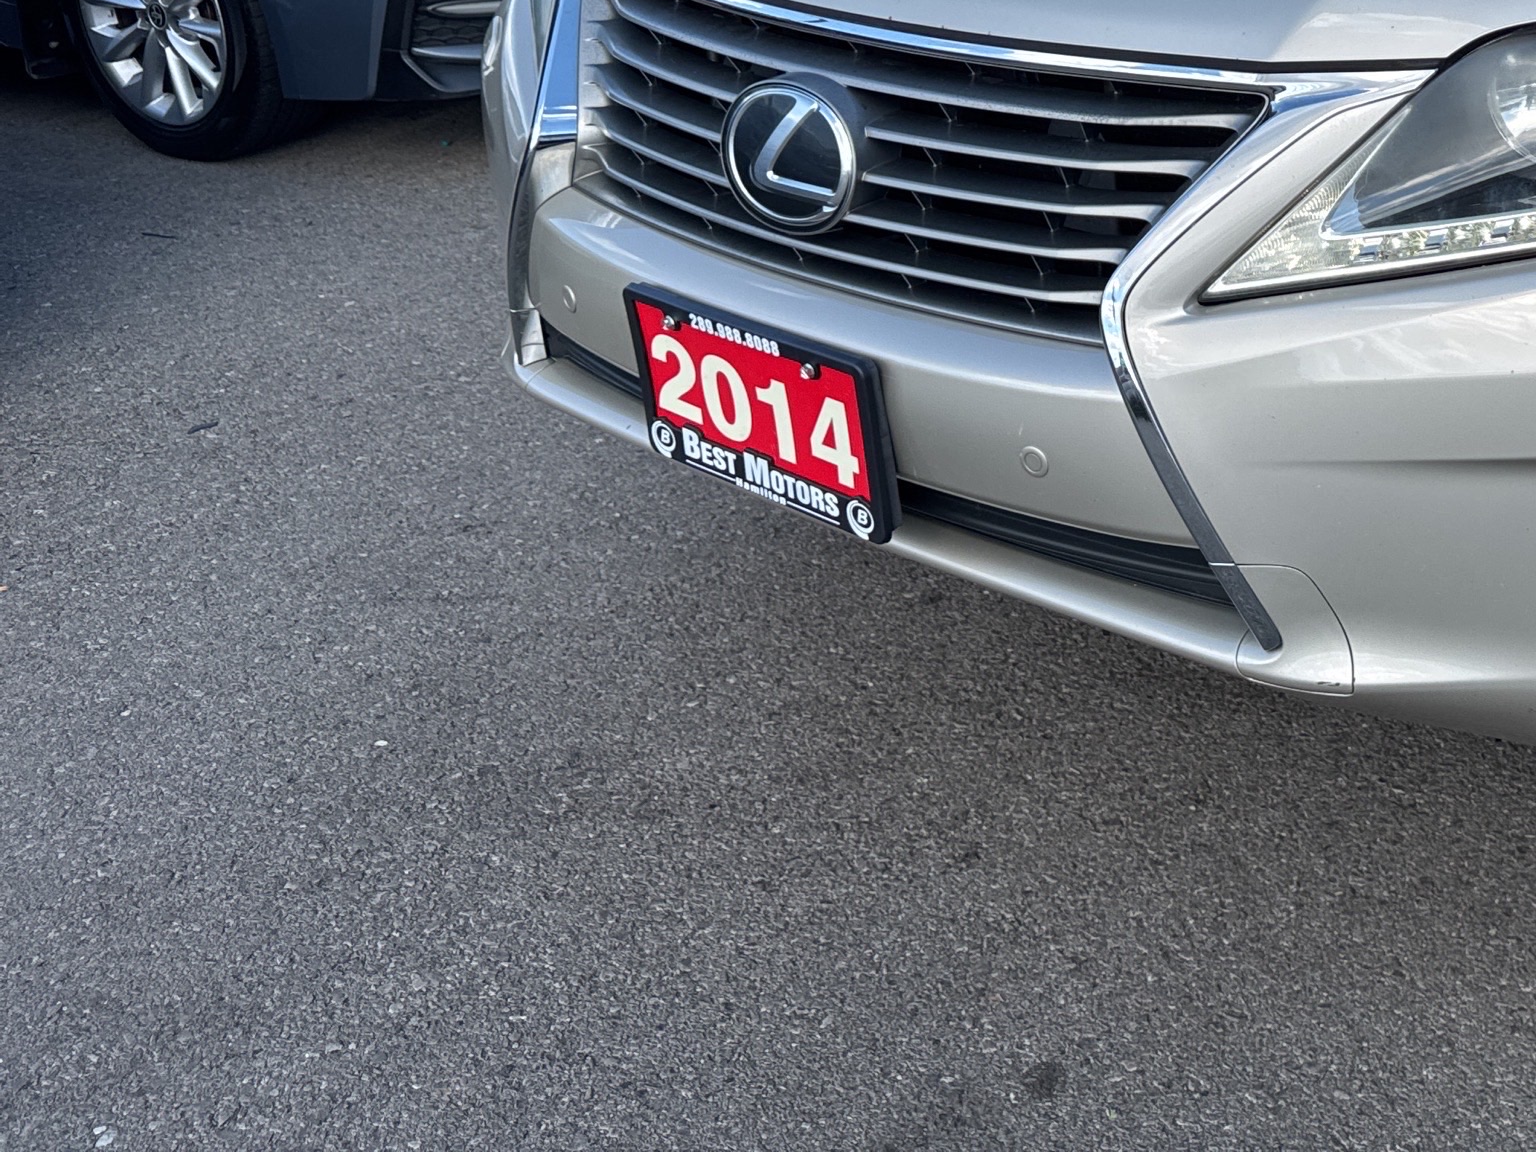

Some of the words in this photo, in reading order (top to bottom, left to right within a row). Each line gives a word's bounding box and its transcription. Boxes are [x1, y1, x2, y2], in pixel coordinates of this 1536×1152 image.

[688, 312, 781, 357] 289.988.8088
[650, 333, 860, 489] 2014
[681, 427, 738, 475] BEST
[742, 451, 841, 518] MOTORS
[735, 476, 787, 506] Hamilton
